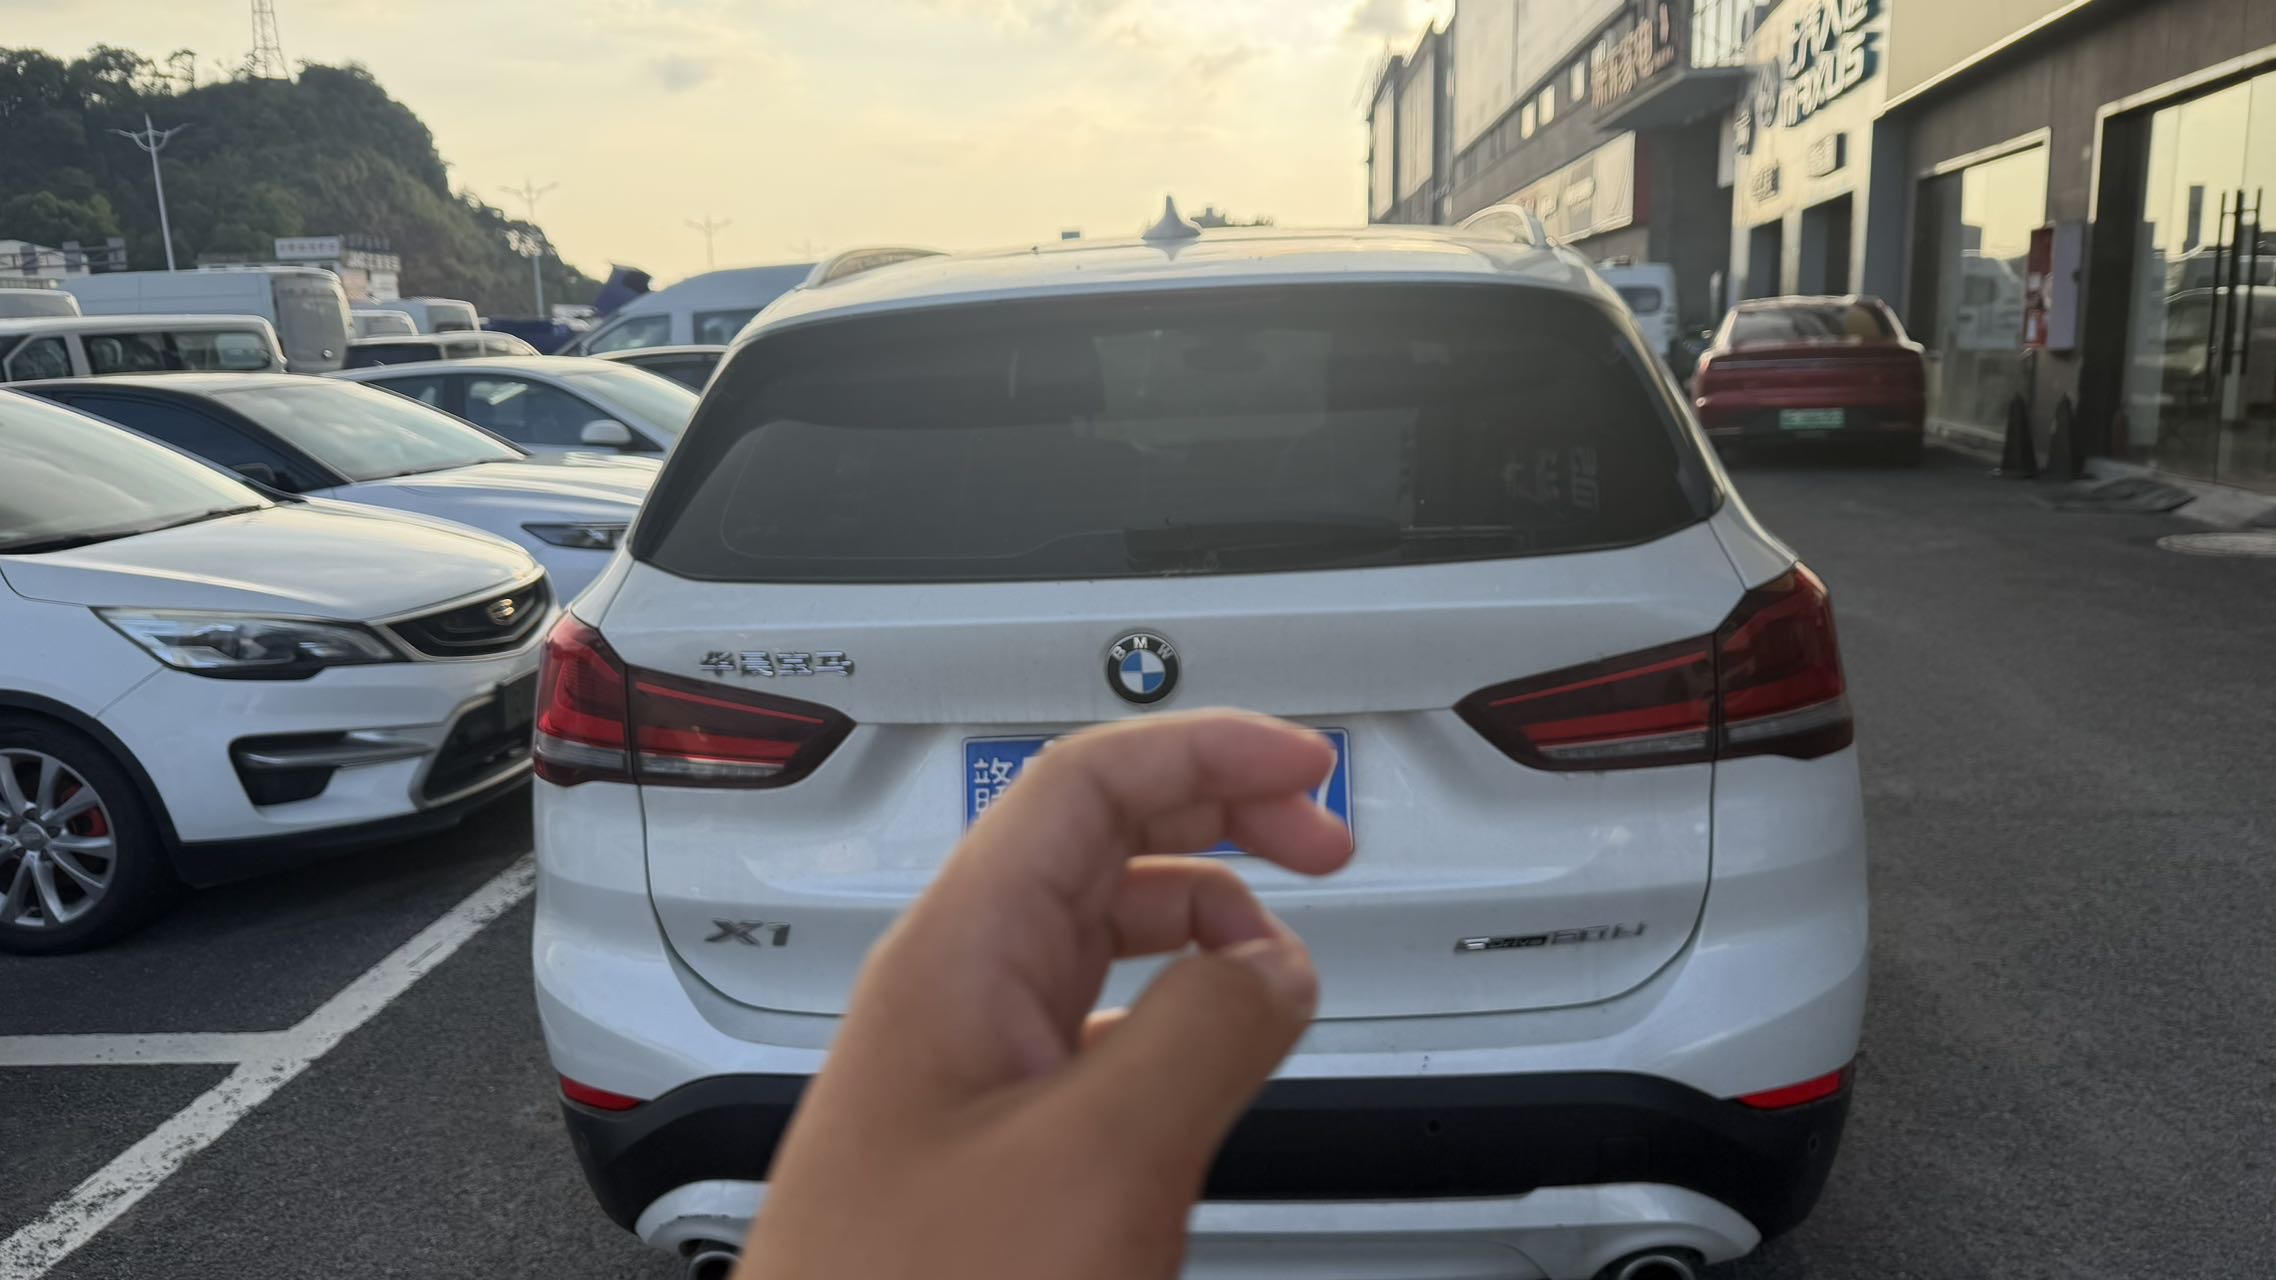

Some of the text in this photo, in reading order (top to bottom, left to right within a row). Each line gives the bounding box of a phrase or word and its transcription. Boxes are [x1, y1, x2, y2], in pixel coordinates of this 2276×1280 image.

[1111, 636, 1175, 661] BMW
[699, 650, 853, 677] 华晨宝马
[705, 920, 791, 946] X1
